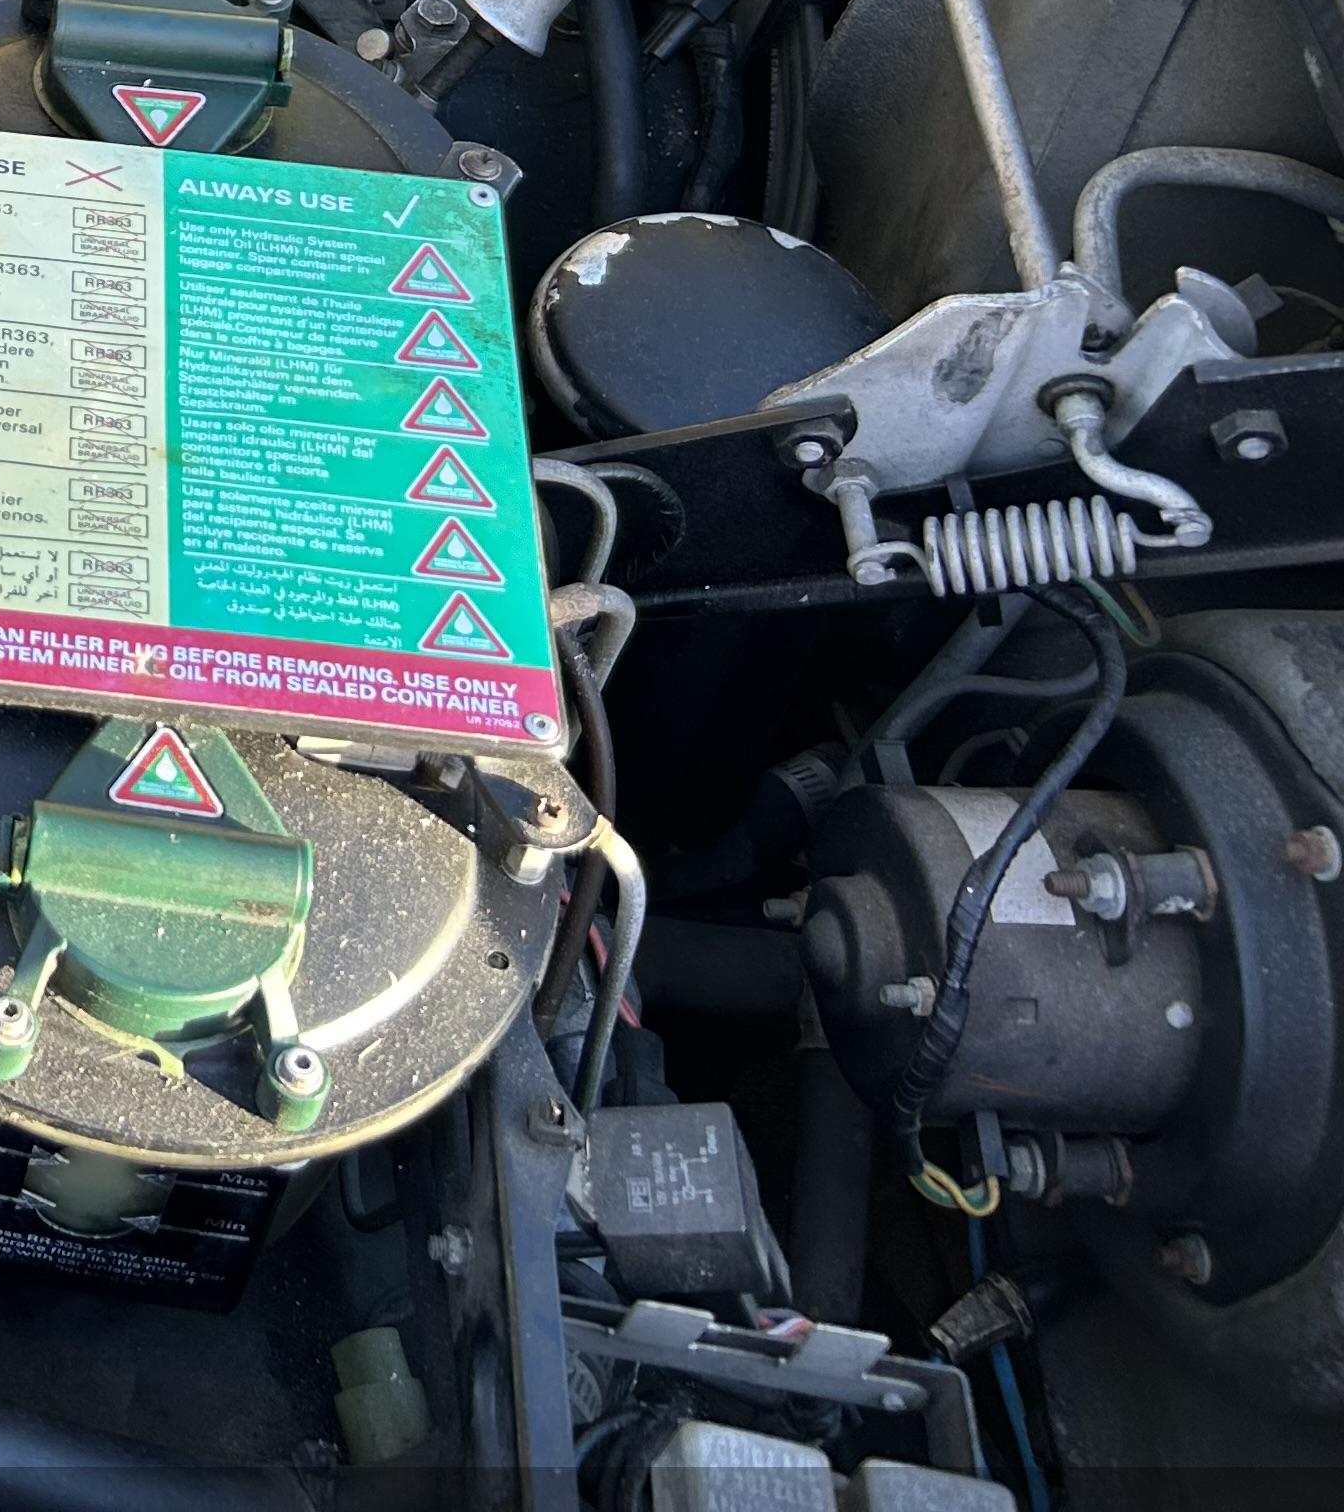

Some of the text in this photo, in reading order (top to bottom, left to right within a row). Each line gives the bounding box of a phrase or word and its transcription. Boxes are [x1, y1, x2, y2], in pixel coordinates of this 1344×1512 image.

[178, 178, 354, 212] ALWAYS USE
[179, 221, 357, 252] Use only Hydraulic System
[179, 232, 385, 266] Mineral Oil (LHM) from special
[179, 255, 232, 272] luggage
[248, 251, 286, 267] Spare
[291, 257, 352, 273] container
[357, 264, 369, 274] in
[29, 629, 103, 652] FILLER
[109, 638, 167, 661] PLUG
[173, 645, 262, 670] BEFORE
[267, 655, 398, 685] REMOVING.
[403, 670, 449, 691] USE
[453, 676, 517, 699] ONLY
[169, 662, 206, 682] OIL
[212, 667, 280, 690] FROM
[286, 675, 376, 700] SEALED
[381, 686, 519, 717] CONTAINER
[219, 1171, 270, 1189] Max
[204, 1216, 248, 1233] Min
